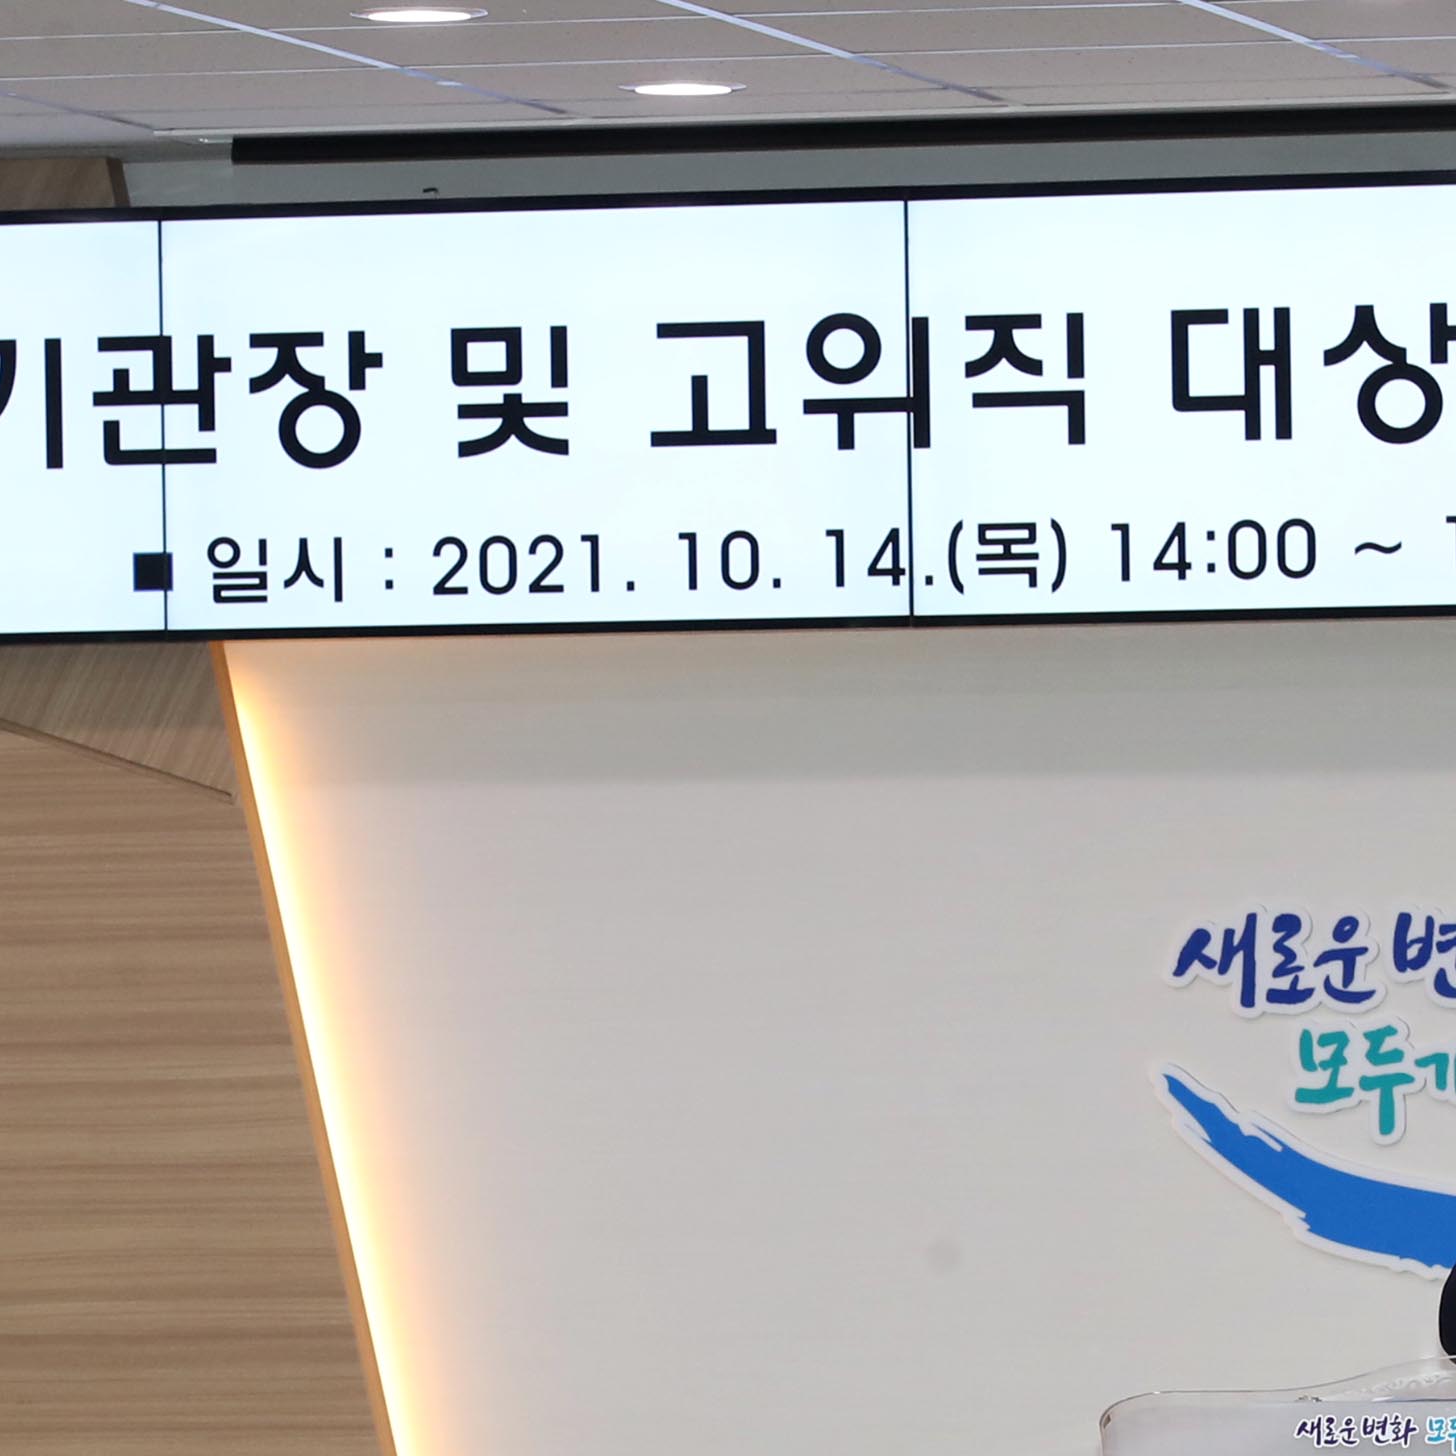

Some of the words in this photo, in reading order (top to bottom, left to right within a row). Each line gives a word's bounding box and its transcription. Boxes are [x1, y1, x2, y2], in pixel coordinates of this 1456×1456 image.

[450, 325, 570, 460] 및
[649, 312, 1087, 449] 고위직
[205, 534, 346, 606] 일시
[433, 534, 637, 597] 2021.
[679, 531, 782, 592] 10.
[825, 517, 1068, 595] 14.(목)
[1110, 517, 1318, 583] 14:00
[1171, 912, 1378, 1009] 새로운
[1295, 1416, 1358, 1447] 새로운
[1362, 1415, 1417, 1447] 변화
